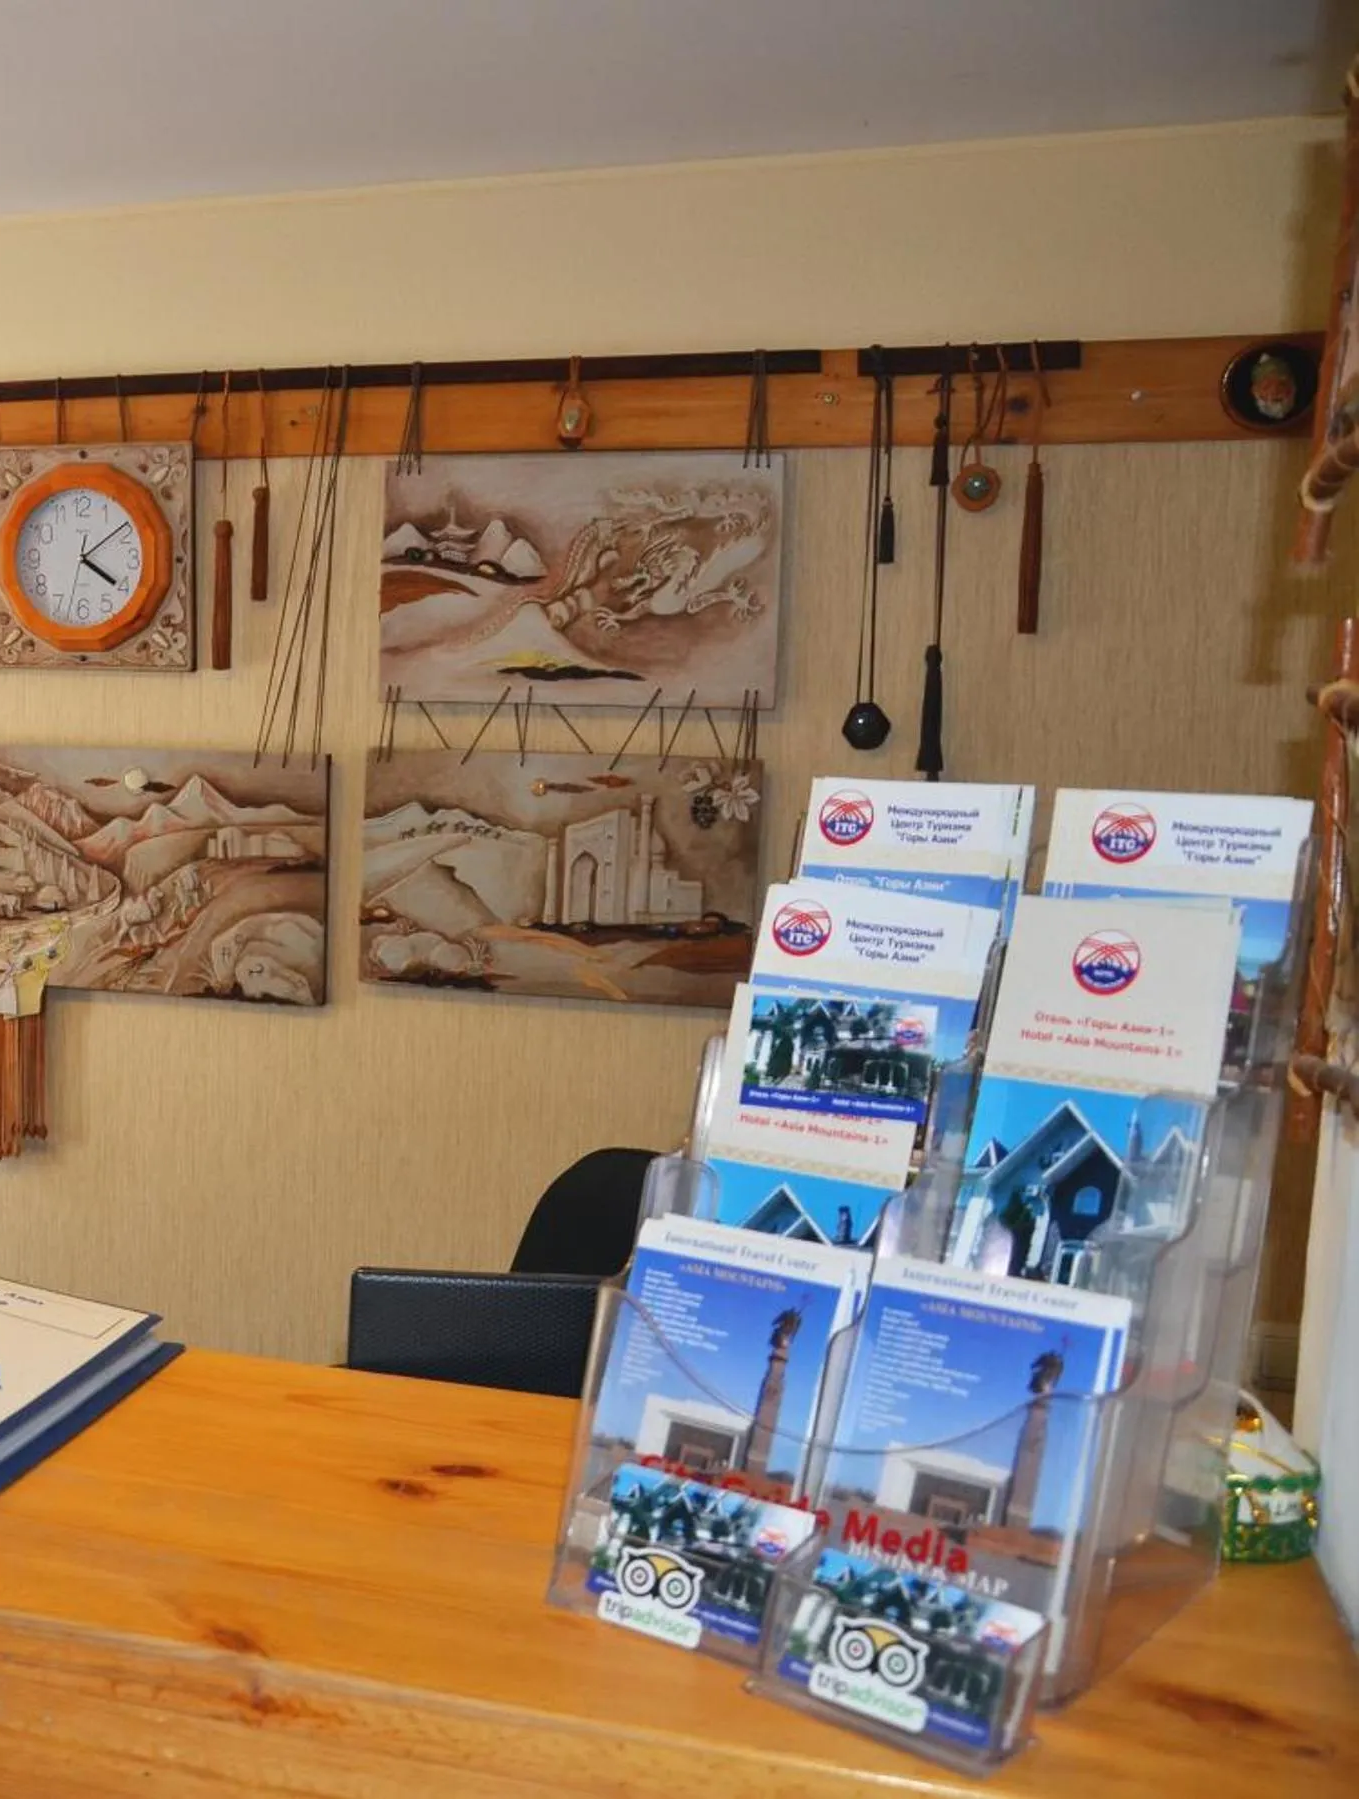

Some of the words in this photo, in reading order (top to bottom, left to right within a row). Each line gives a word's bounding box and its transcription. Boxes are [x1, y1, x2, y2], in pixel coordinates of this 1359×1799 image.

[55, 504, 66, 524] 11
[73, 495, 91, 518] 12
[102, 504, 109, 524] 1
[120, 523, 133, 544] 2
[28, 548, 40, 569] 9
[128, 548, 140, 570] 3
[35, 573, 48, 596] 8
[117, 575, 130, 593] 4
[53, 593, 64, 616] 7
[77, 598, 90, 620] 6
[100, 593, 114, 613] 5
[841, 1508, 970, 1574] Media
[604, 1596, 697, 1639] tripadvisor
[817, 1672, 923, 1718] tripadvisor
